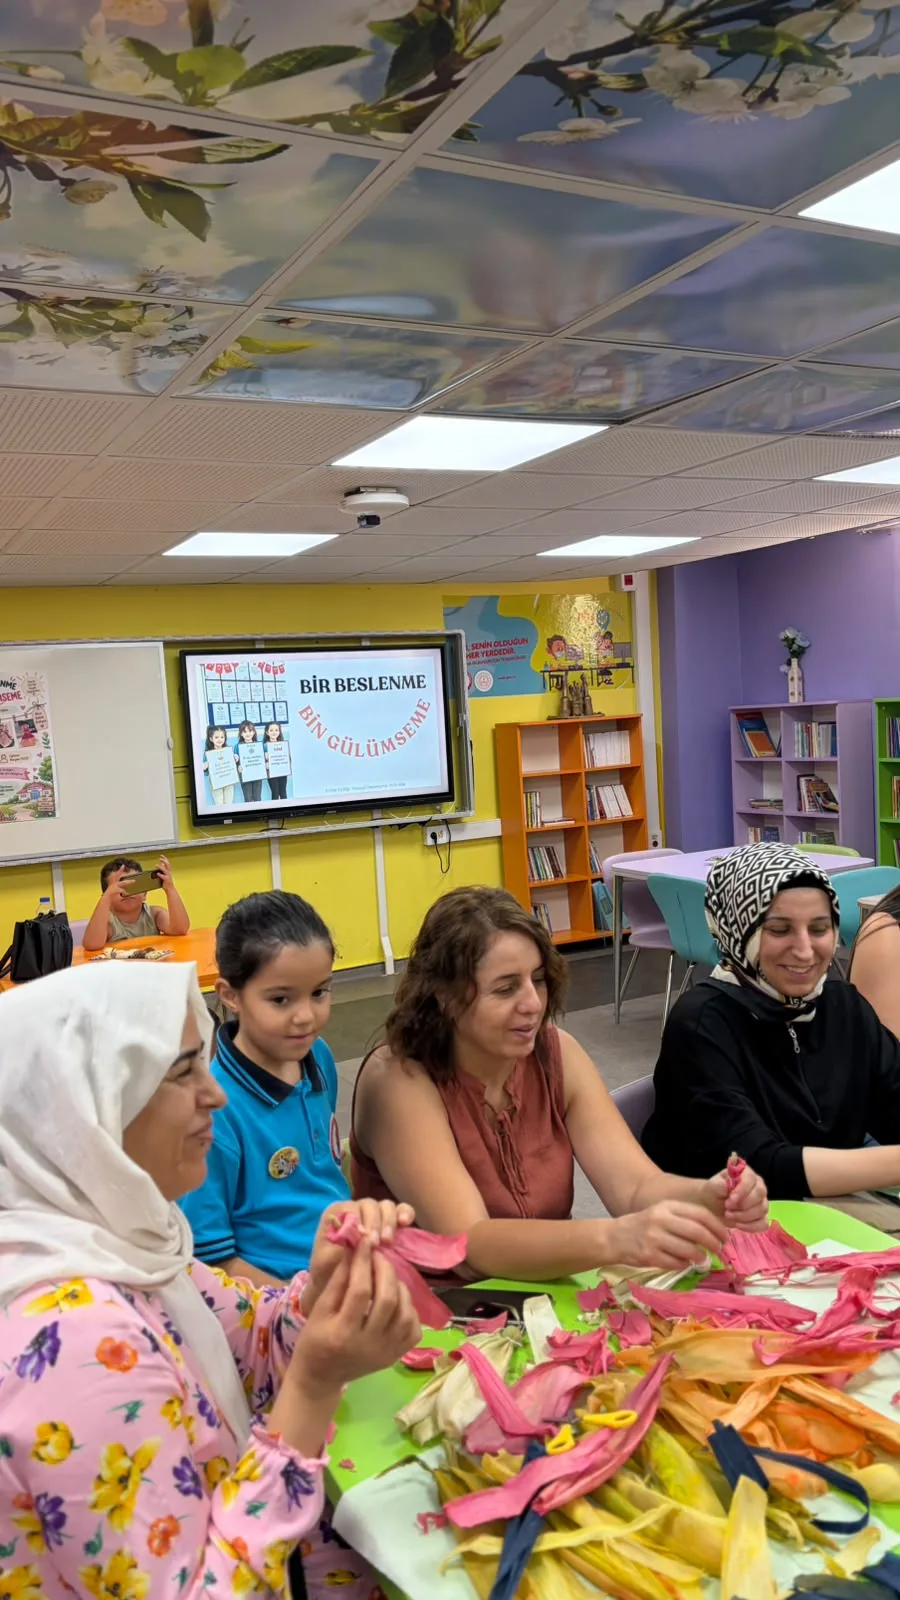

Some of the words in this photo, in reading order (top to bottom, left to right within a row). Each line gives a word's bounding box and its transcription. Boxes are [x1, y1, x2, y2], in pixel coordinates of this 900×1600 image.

[471, 640, 493, 650] SENİN
[300, 675, 331, 694] BİR
[334, 674, 427, 693] BESLENME
[298, 705, 328, 740] BİN
[327, 698, 431, 758] GÜLÜMSEME
